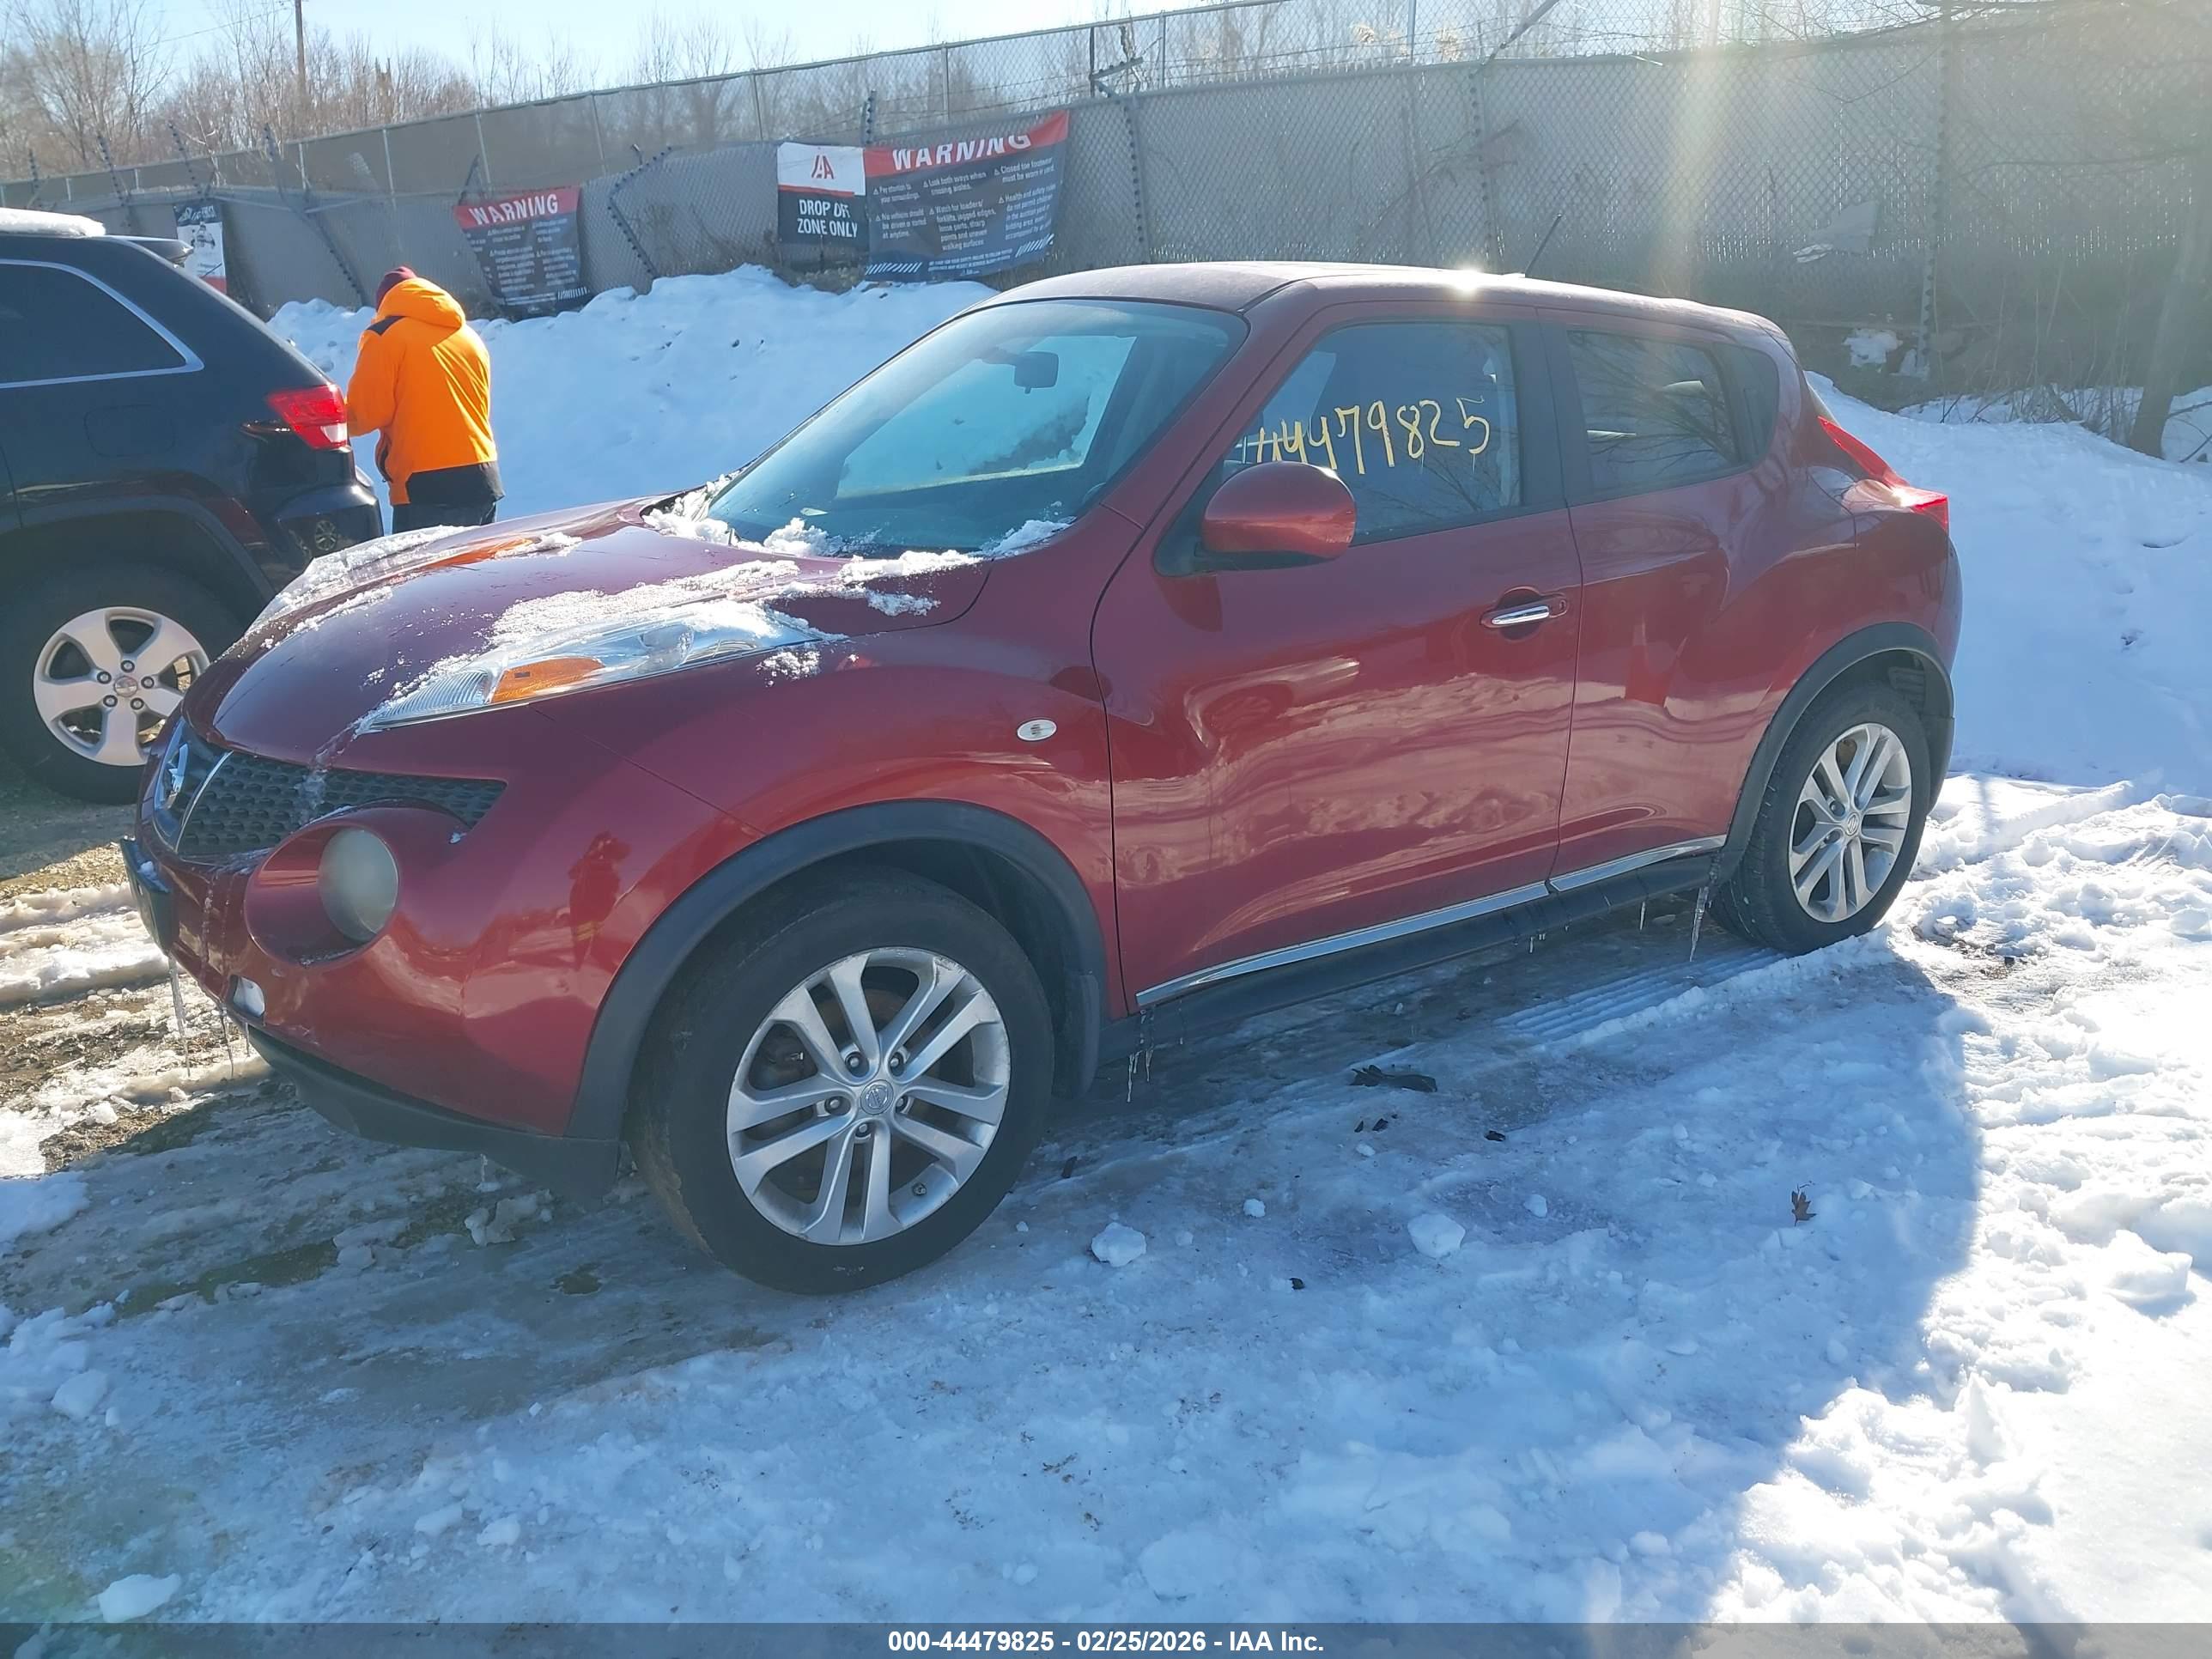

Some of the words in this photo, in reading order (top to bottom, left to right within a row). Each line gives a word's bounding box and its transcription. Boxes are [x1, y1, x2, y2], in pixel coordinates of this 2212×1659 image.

[892, 135, 1031, 171] WARNING
[468, 193, 559, 226] WARNING
[799, 198, 831, 216] DROP
[797, 217, 828, 235] ZONE
[829, 220, 859, 238] ONLY
